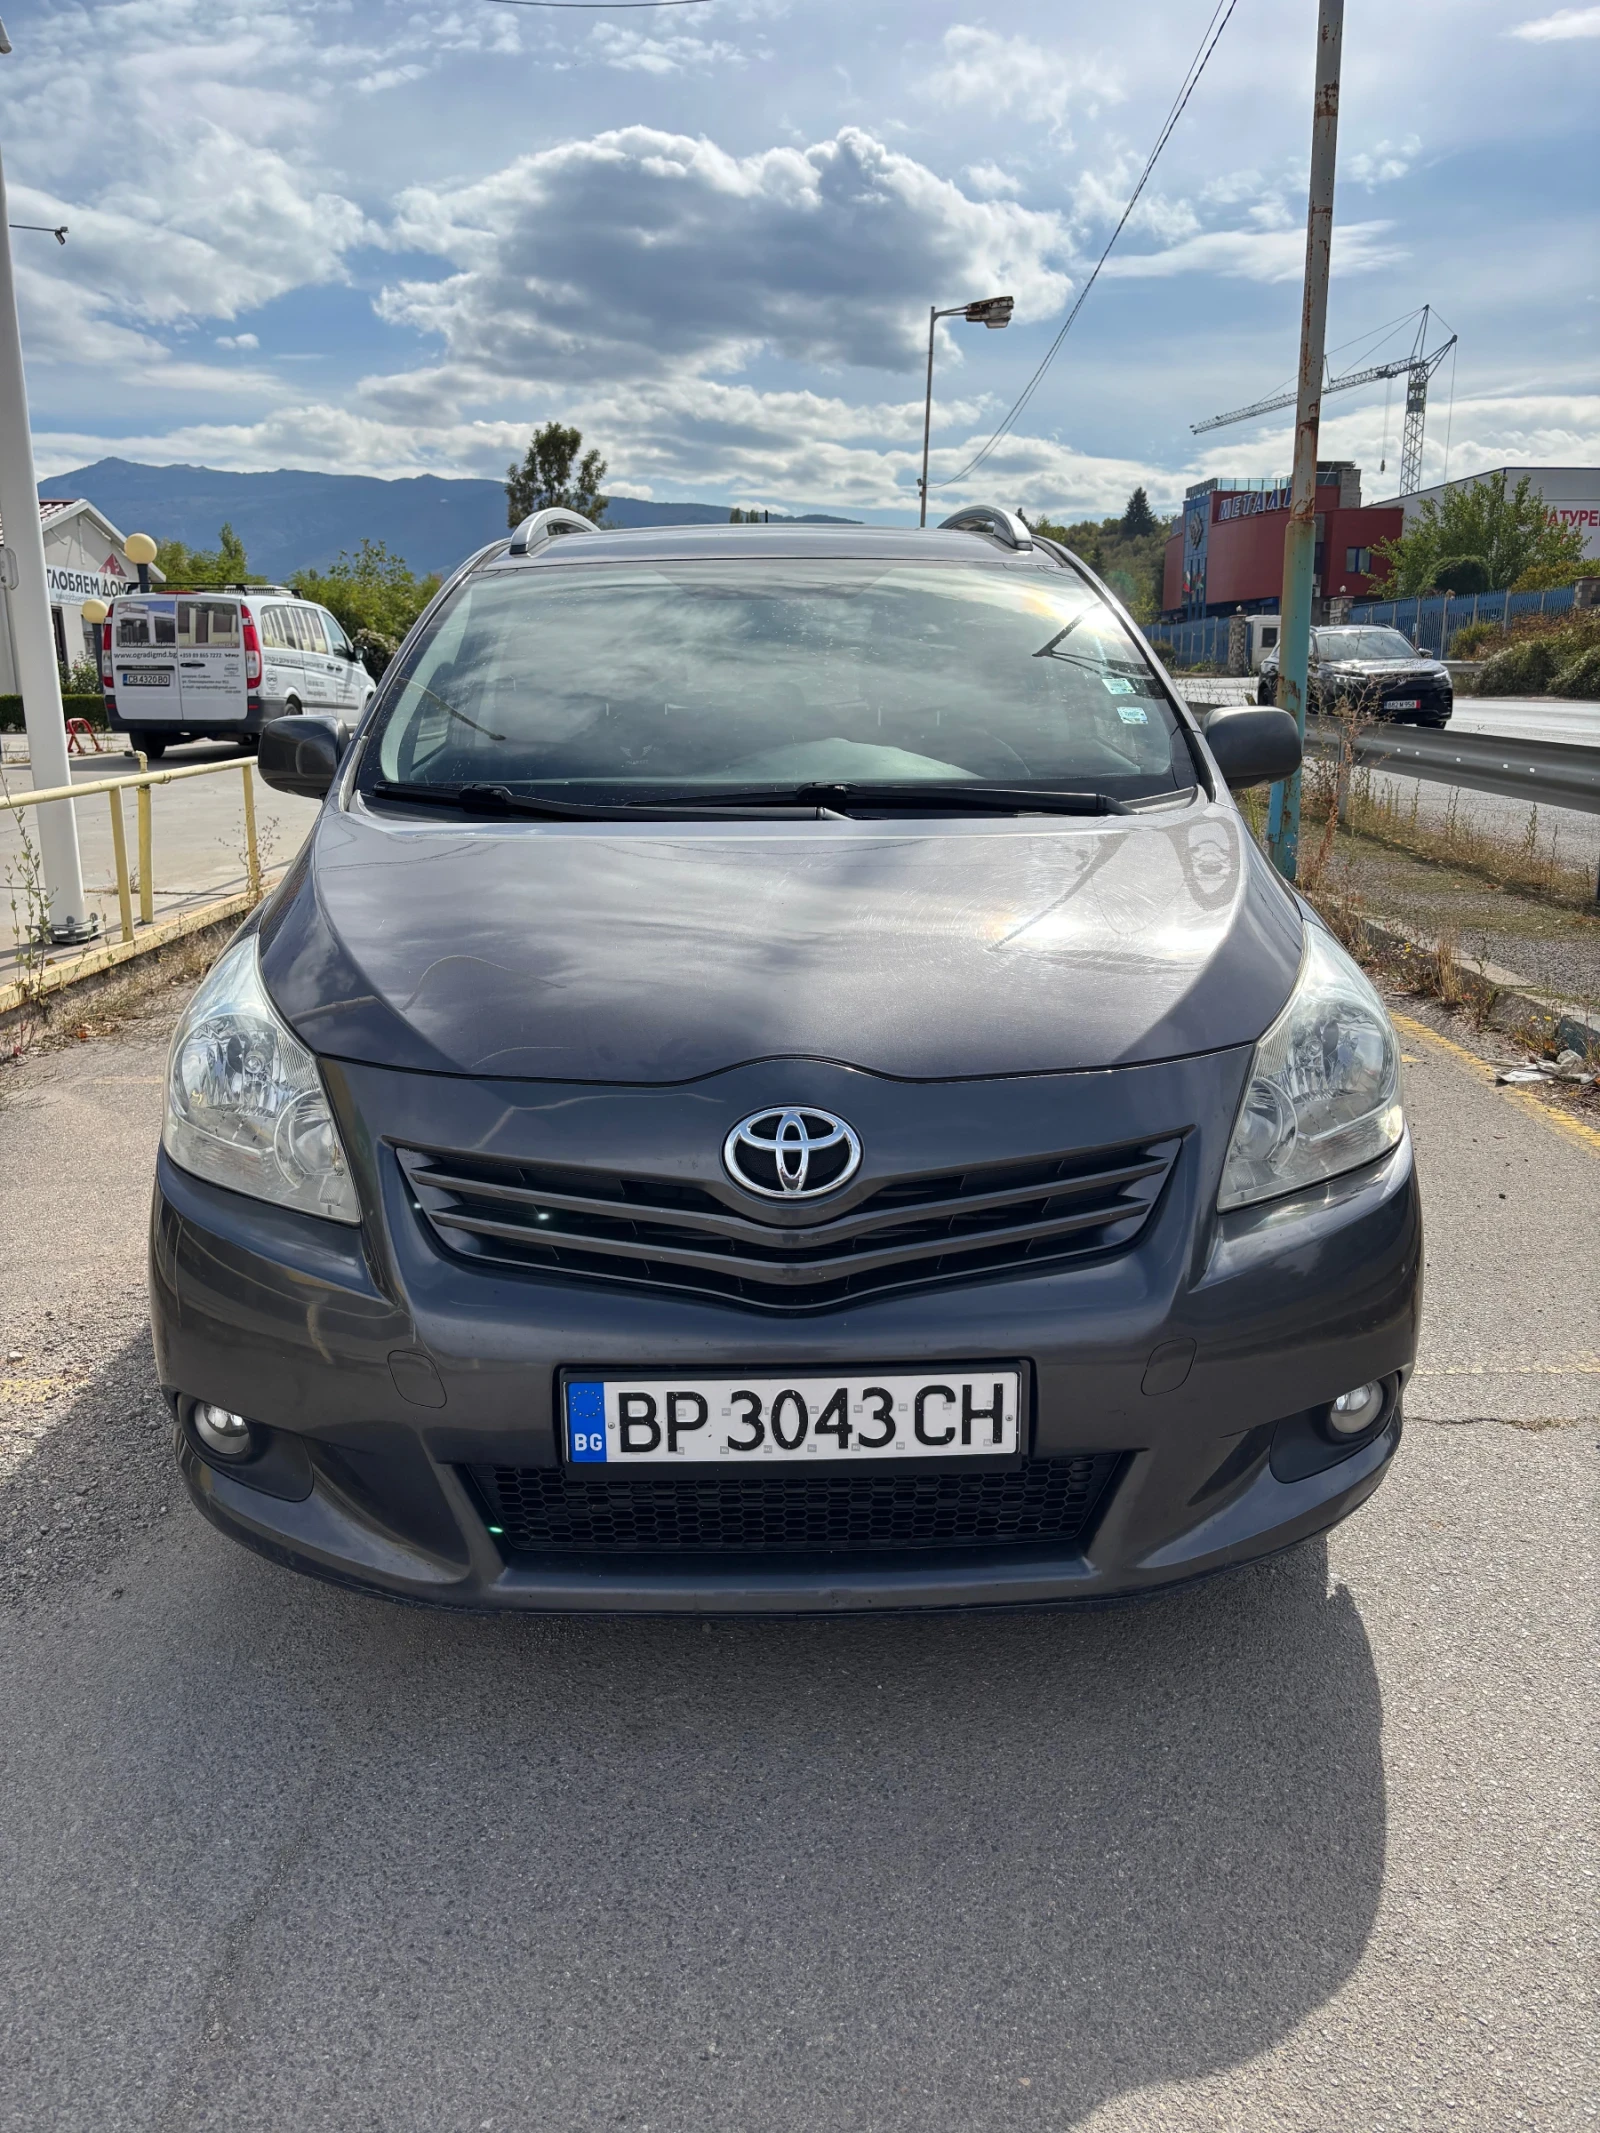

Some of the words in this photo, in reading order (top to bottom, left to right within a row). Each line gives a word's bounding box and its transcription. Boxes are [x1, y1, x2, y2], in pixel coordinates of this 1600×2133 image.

[113, 651, 178, 659] www.ogradigmd.bg
[139, 675, 157, 684] 4320
[618, 1391, 709, 1453] BP
[727, 1386, 896, 1451] 3043
[914, 1383, 1004, 1446] CH
[574, 1433, 603, 1451] BG
